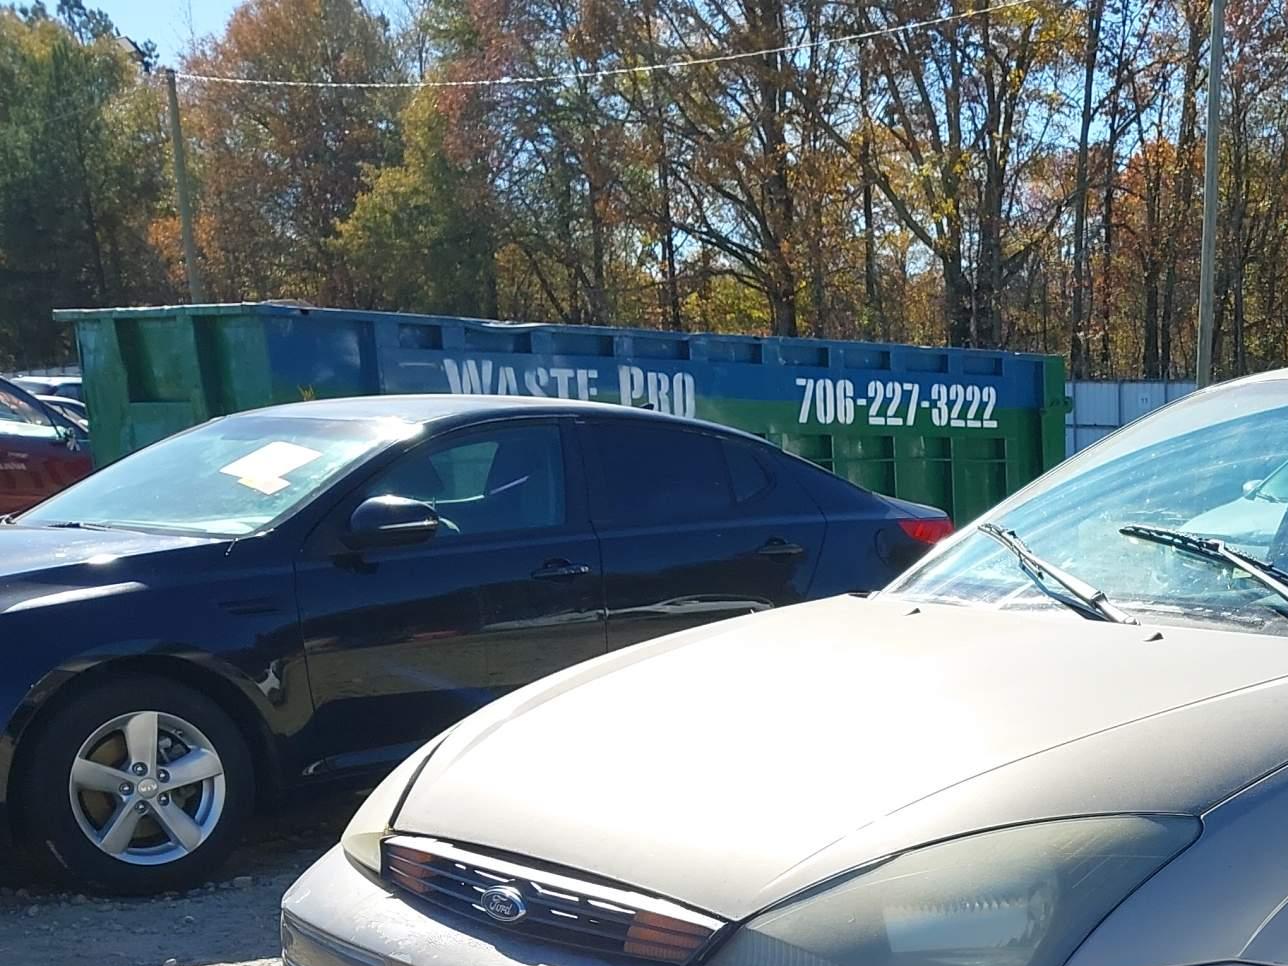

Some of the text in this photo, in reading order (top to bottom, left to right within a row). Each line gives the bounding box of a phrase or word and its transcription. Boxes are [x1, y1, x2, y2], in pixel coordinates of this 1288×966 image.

[443, 358, 696, 419] WASTE PRO
[795, 377, 998, 429] 706-227-3222
[489, 894, 513, 916] Ford
